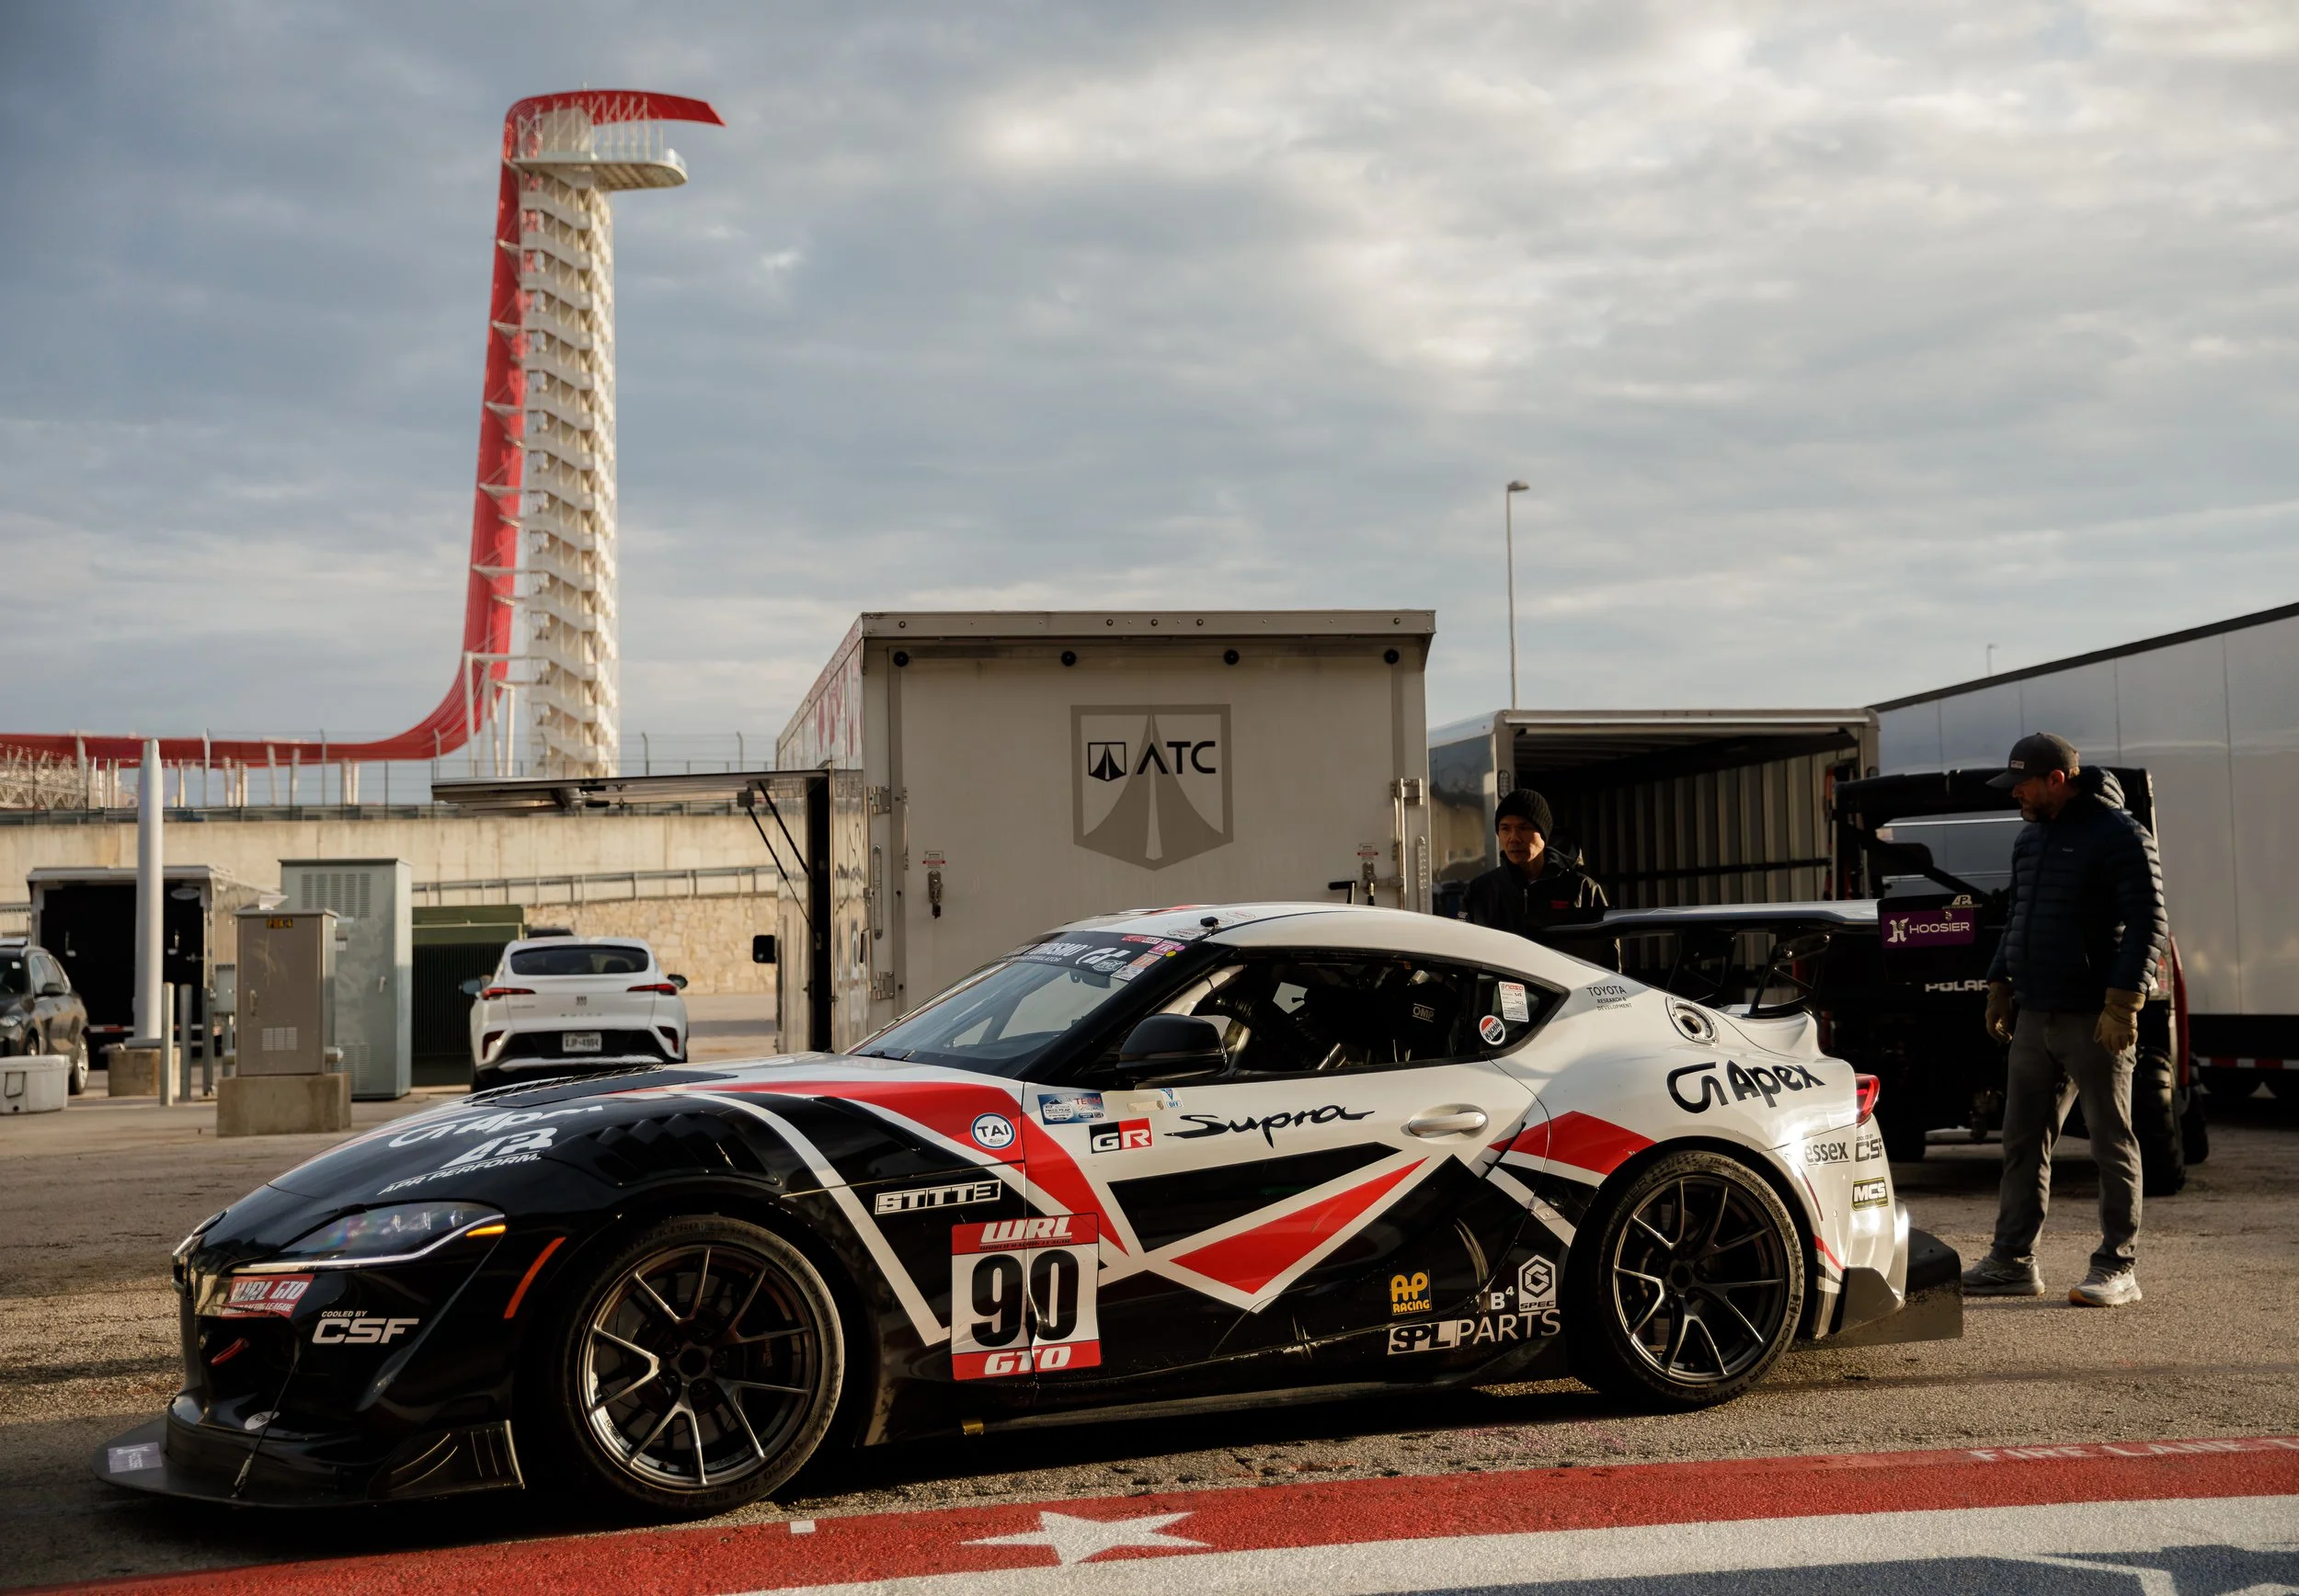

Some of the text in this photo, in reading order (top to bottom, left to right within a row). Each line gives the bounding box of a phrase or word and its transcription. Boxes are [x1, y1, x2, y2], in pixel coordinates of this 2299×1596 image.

[1137, 741, 1216, 774] ATC
[1909, 922, 1970, 934] HOOSIER
[1586, 986, 1628, 997] TOYOTA
[1413, 1007, 1435, 1020] OMP
[1597, 1003, 1632, 1011] DEVELOPMENT
[1074, 1097, 1101, 1105] TECH
[977, 1123, 1010, 1137] TAI
[1163, 1105, 1375, 1148] Supra
[1092, 1129, 1151, 1152] GR
[1805, 1142, 1849, 1163] essex
[377, 1153, 542, 1195] APR PERFORM.
[1853, 1181, 1886, 1203] MCS
[980, 1217, 1072, 1244] WRL
[229, 1281, 310, 1304] WRL GTO
[971, 1248, 1079, 1348] 90
[1390, 1272, 1428, 1303] AP
[266, 1303, 295, 1312] LEAGUE
[1392, 1299, 1430, 1313] RACING
[1519, 1300, 1556, 1309] SPEC
[312, 1318, 419, 1343] CSF
[1390, 1309, 1561, 1352] SPL PARTS
[984, 1346, 1071, 1374] GTO
[1748, 1314, 1798, 1385] HOOSIER
[1970, 1446, 2086, 1461] FIRE
[2101, 1440, 2244, 1457] LANE
